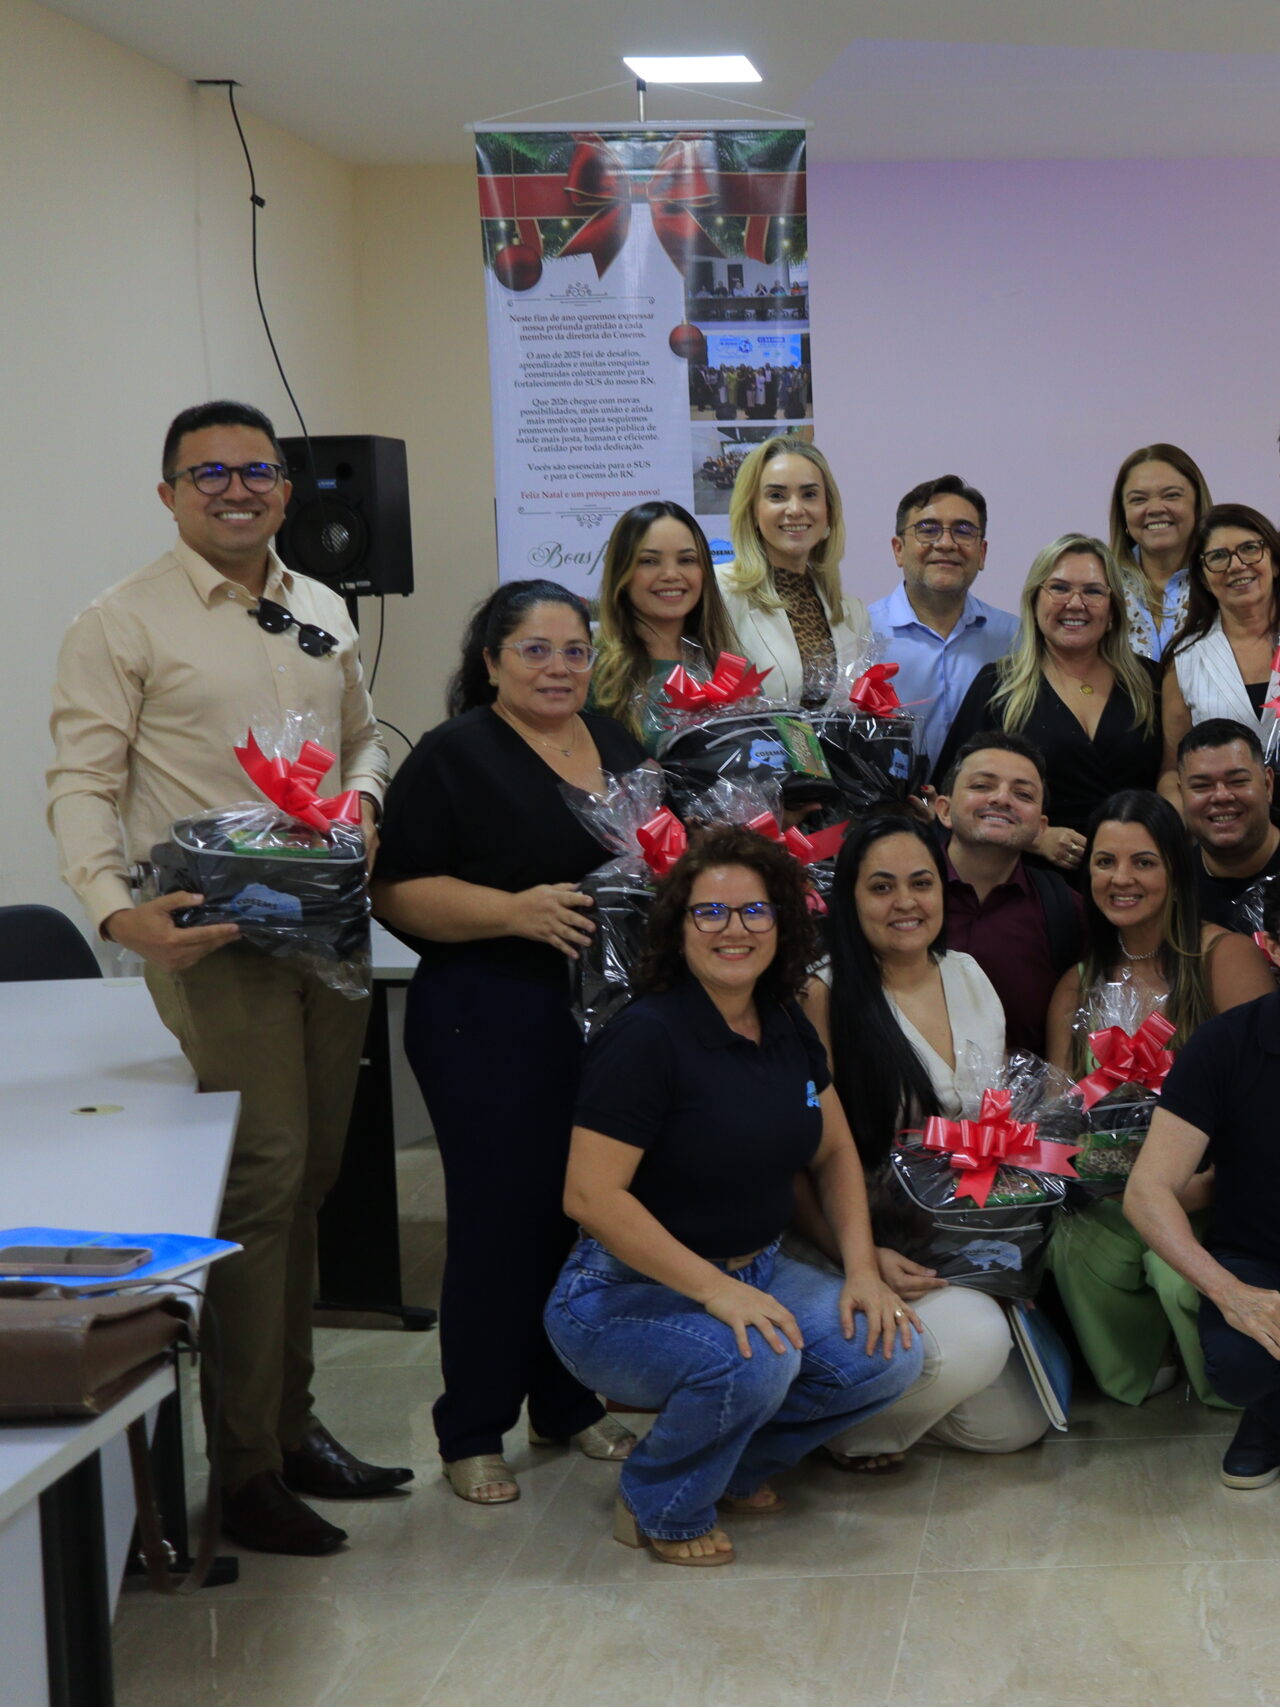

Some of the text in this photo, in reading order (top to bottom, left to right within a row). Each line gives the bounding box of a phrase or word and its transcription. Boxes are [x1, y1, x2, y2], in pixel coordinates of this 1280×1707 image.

[618, 313, 654, 321] expressar
[546, 323, 582, 332] profunda
[585, 322, 616, 331] gratidão
[566, 332, 599, 340] diretoria
[519, 361, 571, 369] aprendizados
[608, 359, 649, 368] conquistas
[572, 369, 625, 377] coletivamente
[515, 380, 571, 388] fortalecimento
[532, 399, 549, 407] Que
[570, 398, 597, 406] chegue
[547, 417, 587, 425] motivação
[519, 427, 568, 435] promovendo
[521, 491, 539, 499] Feliz
[542, 491, 563, 499] Natal
[528, 541, 592, 569] Boas
